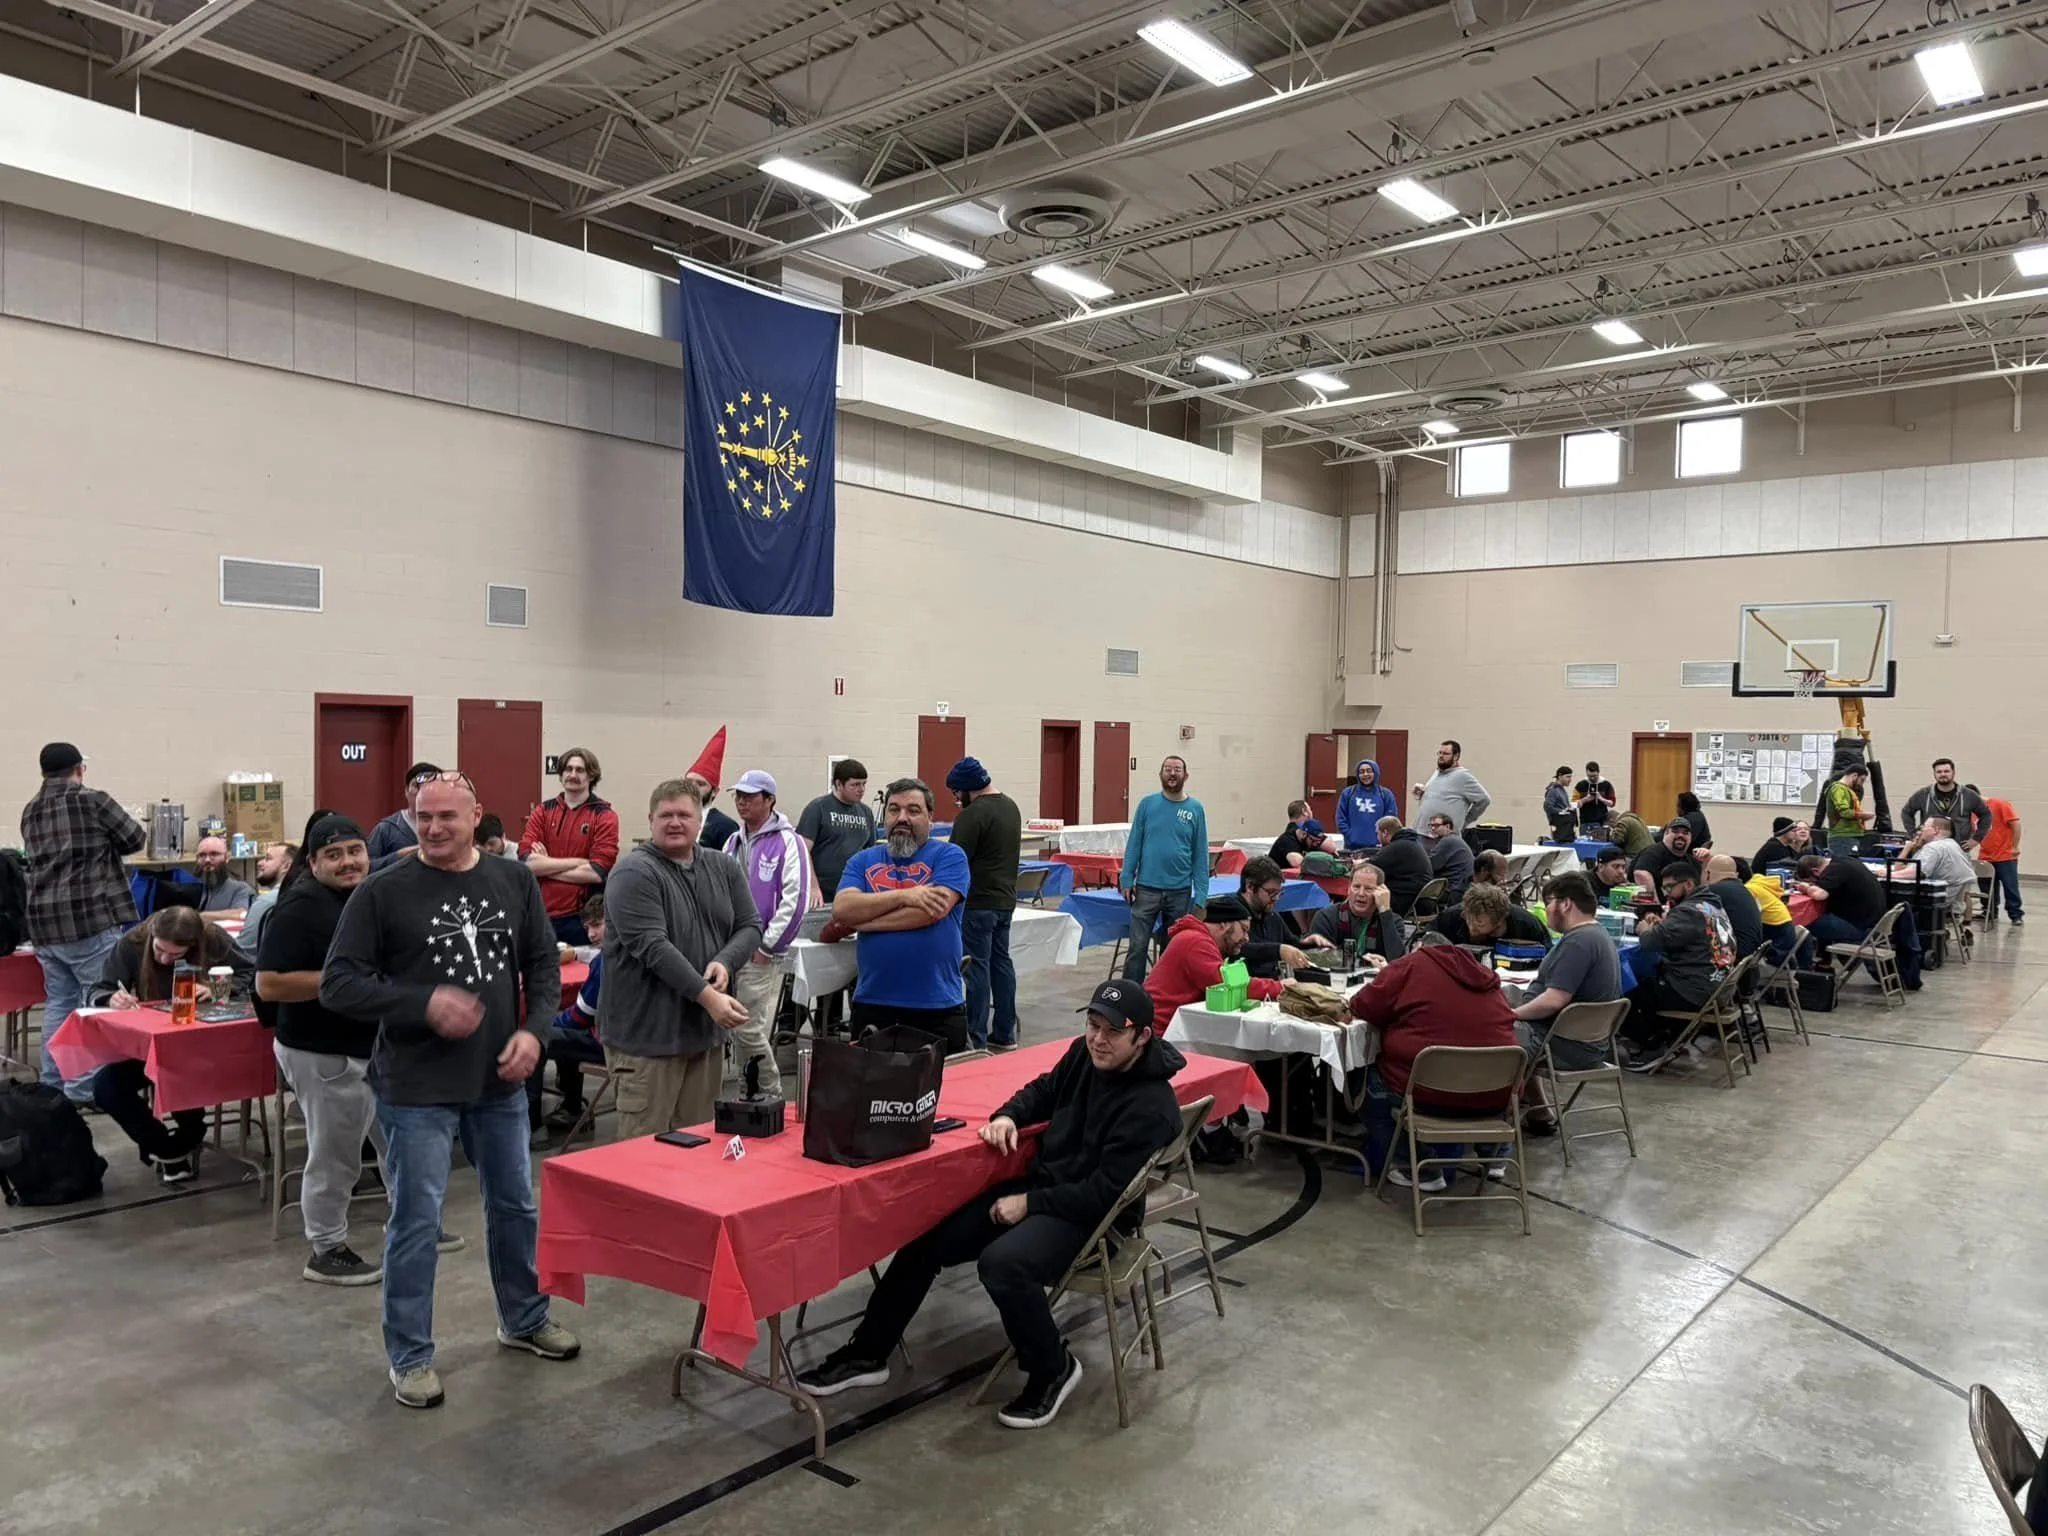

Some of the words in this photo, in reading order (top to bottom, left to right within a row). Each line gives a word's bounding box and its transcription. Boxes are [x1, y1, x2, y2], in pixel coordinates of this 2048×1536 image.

[342, 744, 367, 760] OUT
[870, 1100, 914, 1115] MICRO
[869, 1115, 909, 1124] computers
[732, 1140, 744, 1156] 24
